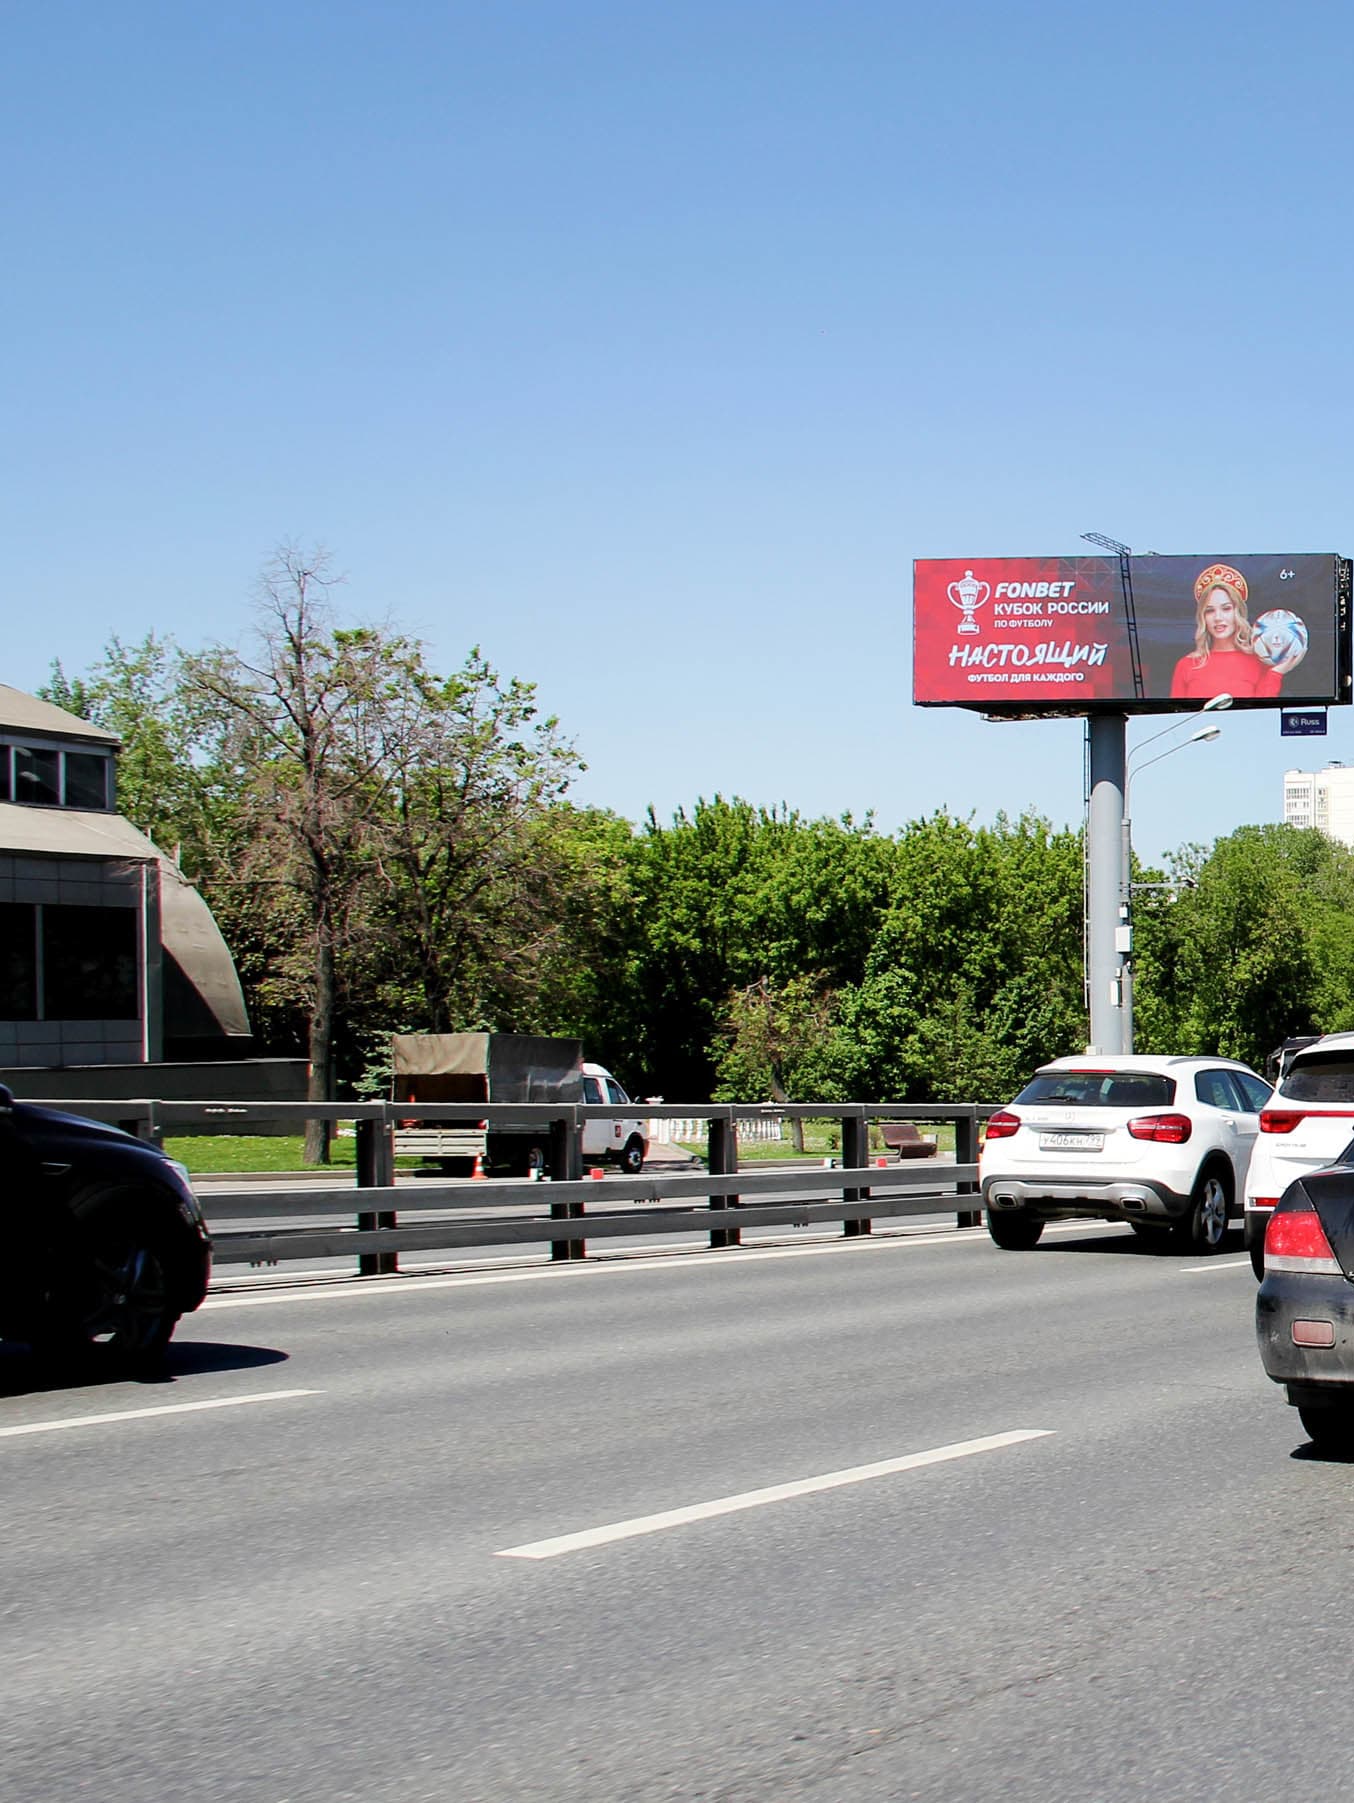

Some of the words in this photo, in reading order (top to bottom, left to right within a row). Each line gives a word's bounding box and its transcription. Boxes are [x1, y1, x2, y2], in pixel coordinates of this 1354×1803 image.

[1279, 568, 1296, 580] 6+
[995, 582, 1074, 598] FONBET
[994, 602, 1043, 616] КУБОК
[1047, 601, 1110, 615] РОССИИ
[994, 619, 1007, 628] ПО
[1008, 619, 1054, 628] ФУТБОЛУ
[949, 641, 1108, 668] НАСТОЯЩИЙ
[967, 673, 1009, 683] ФУТБОЛ
[1010, 673, 1032, 684] ДЛЯ
[1032, 672, 1085, 683] КАЖДОГО
